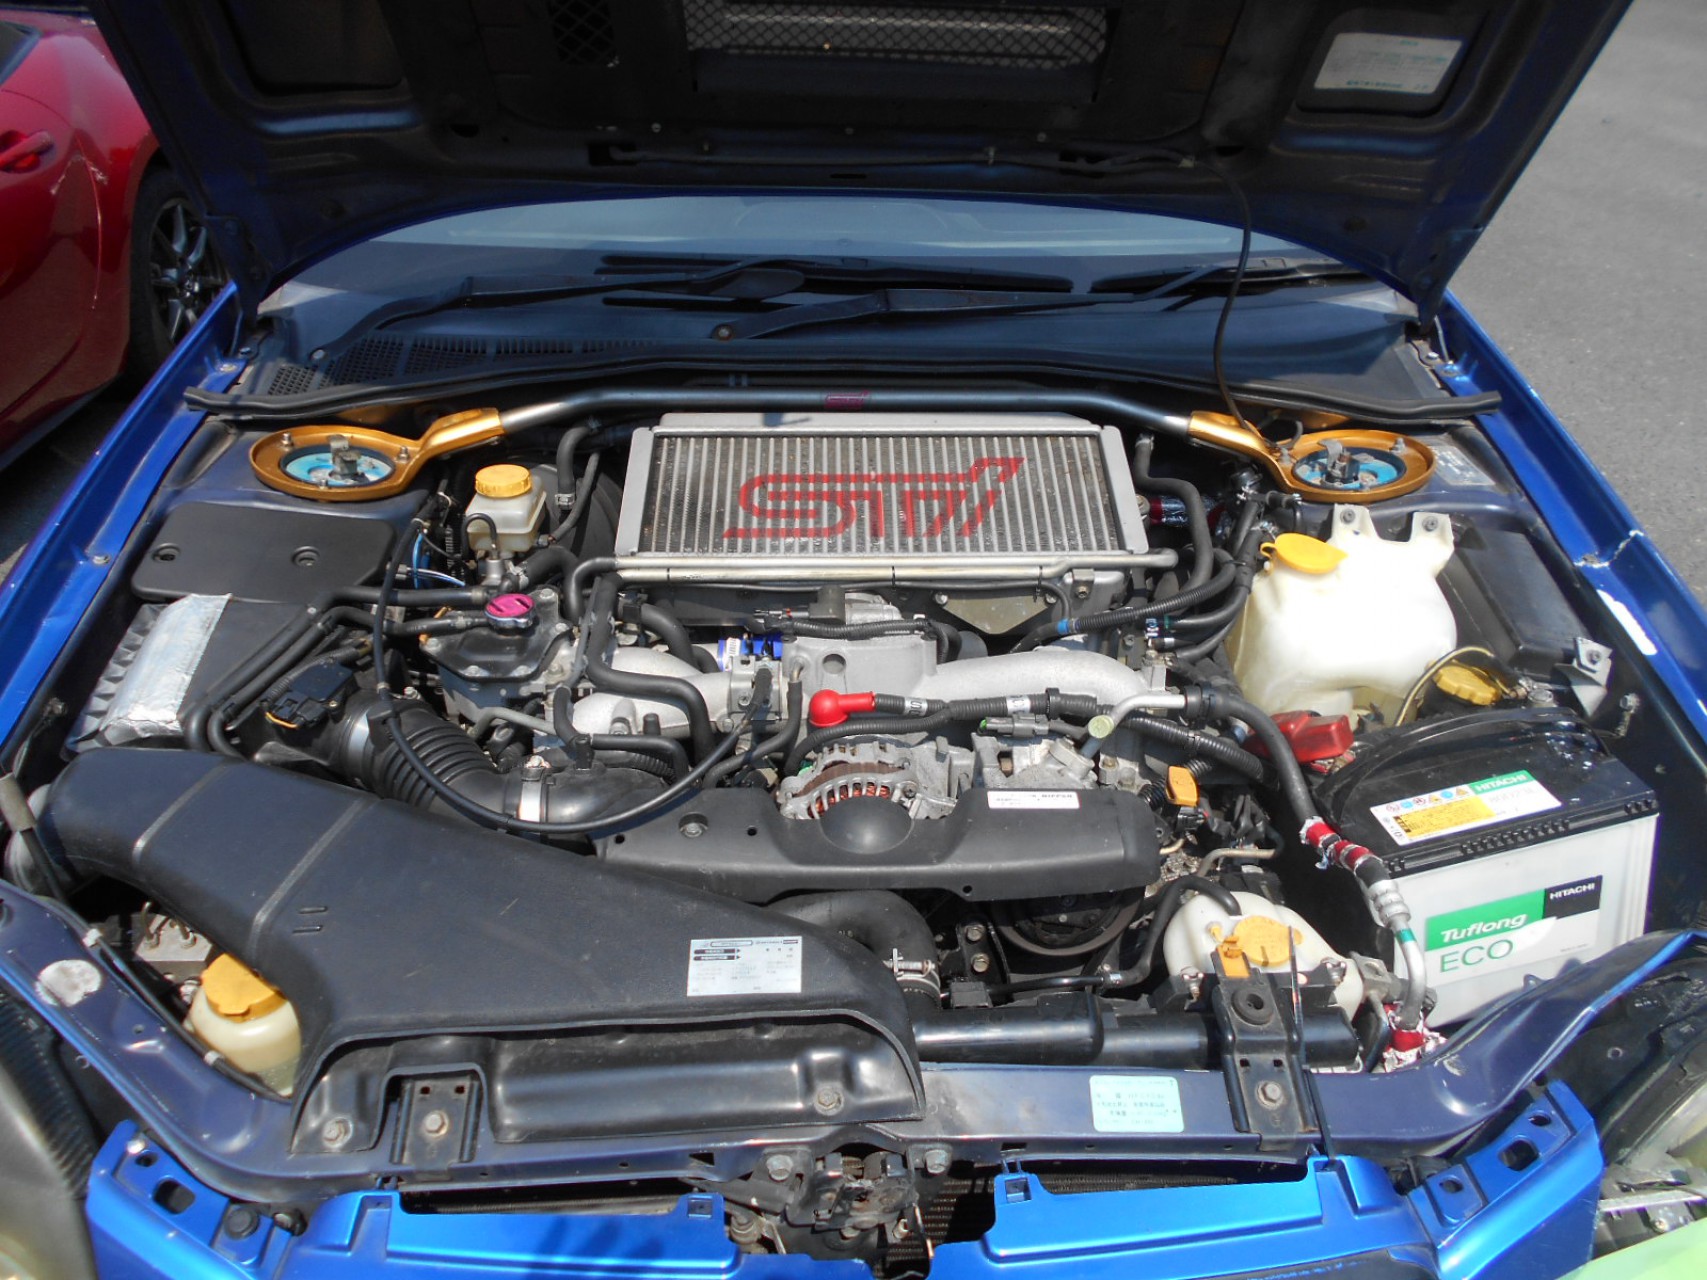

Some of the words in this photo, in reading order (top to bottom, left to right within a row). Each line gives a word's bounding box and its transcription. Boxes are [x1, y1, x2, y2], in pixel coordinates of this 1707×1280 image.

[1474, 773, 1528, 793] HITACHI
[1549, 883, 1595, 900] HITACHI
[1440, 914, 1529, 943] Tuflong
[1440, 939, 1514, 973] ECO
